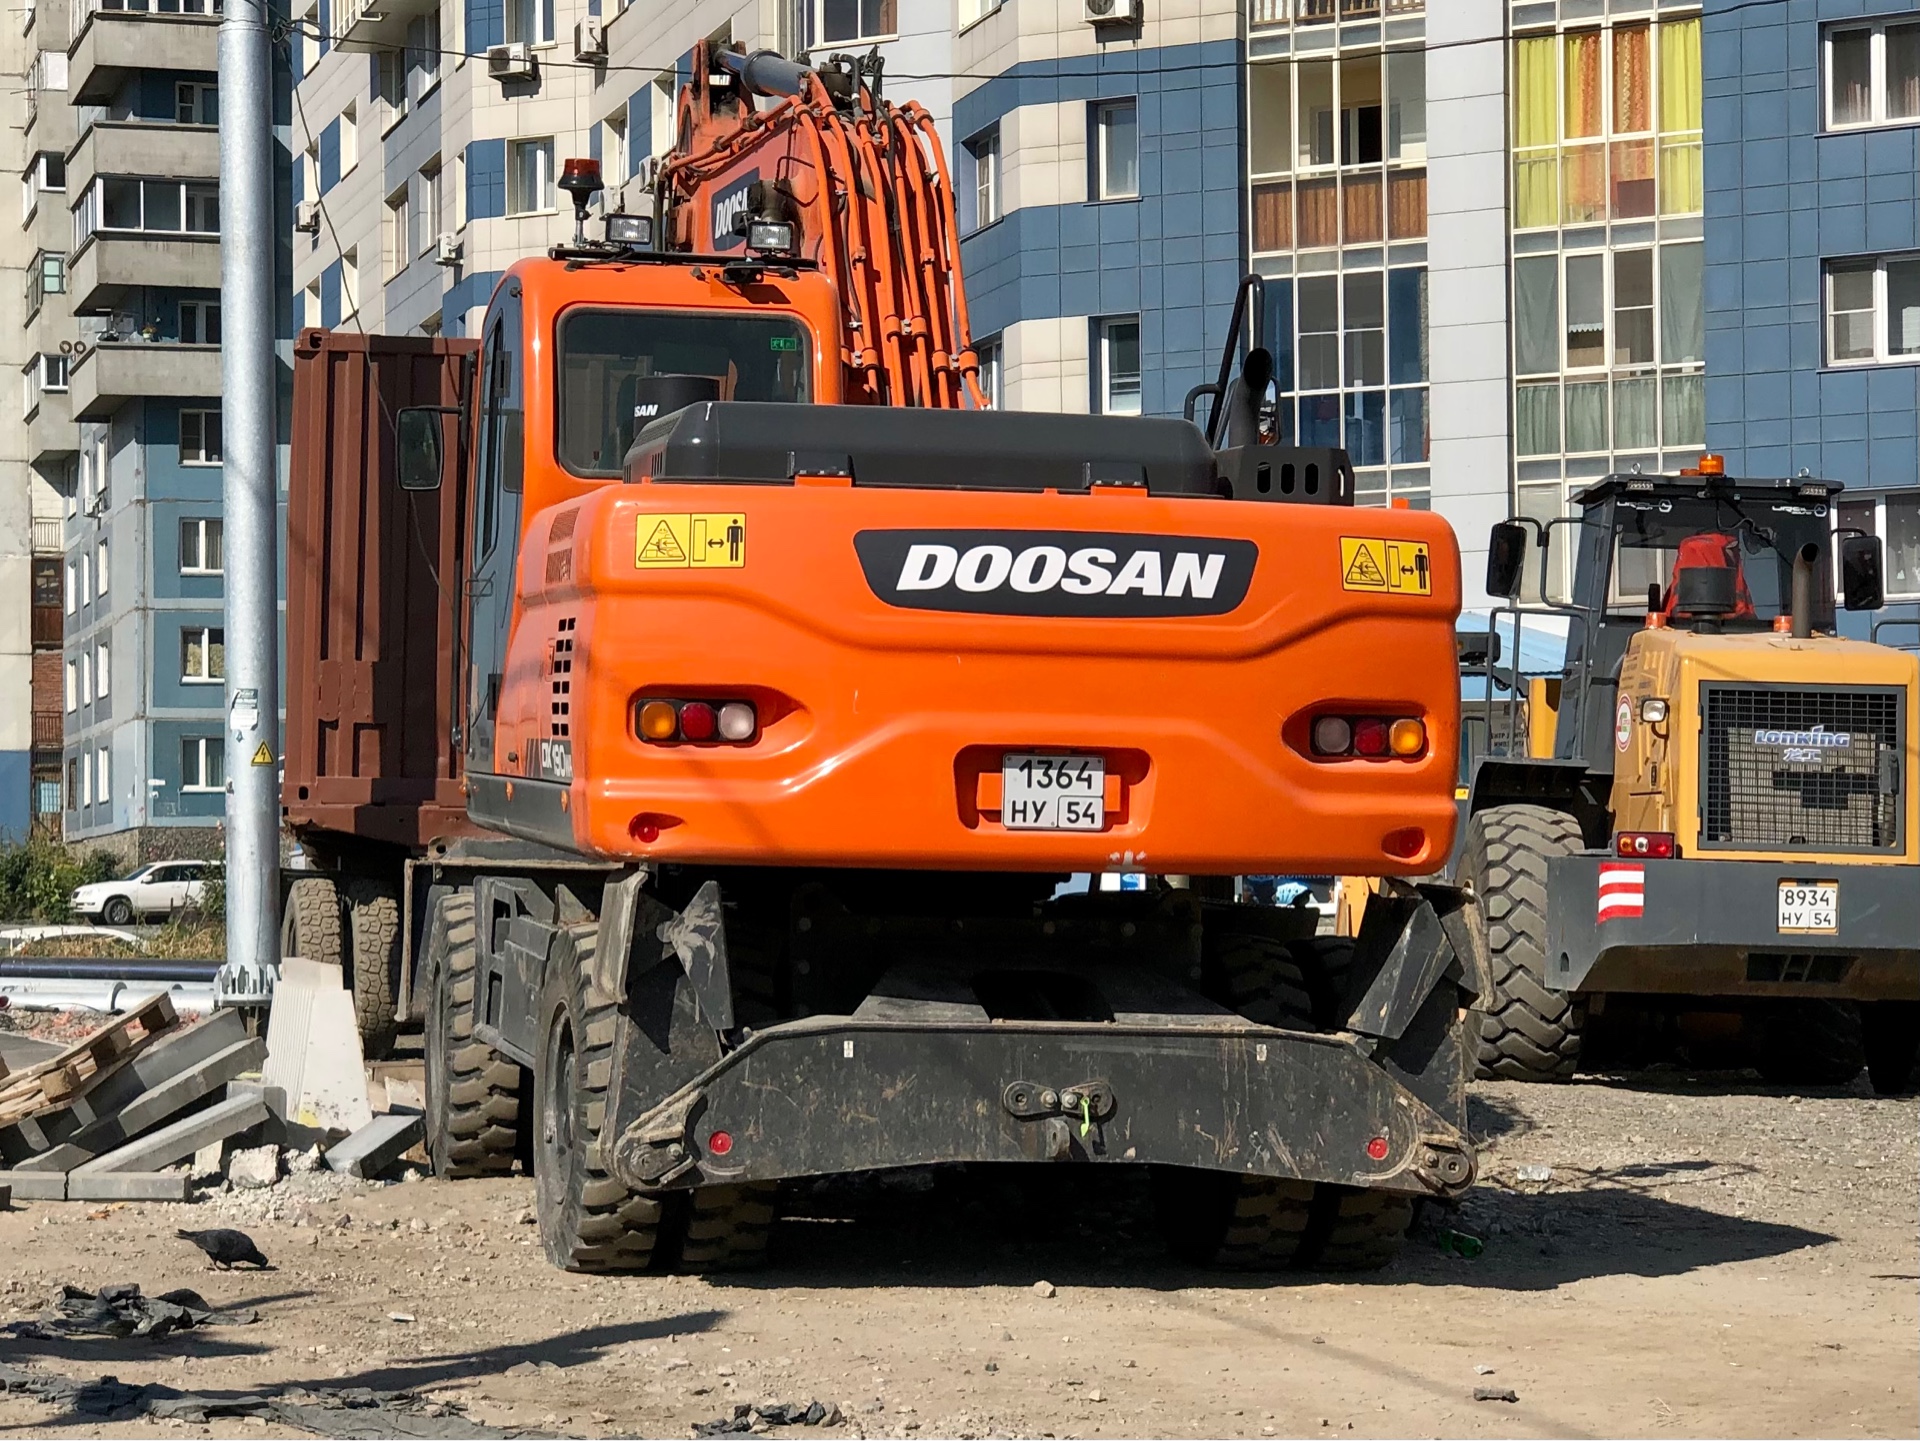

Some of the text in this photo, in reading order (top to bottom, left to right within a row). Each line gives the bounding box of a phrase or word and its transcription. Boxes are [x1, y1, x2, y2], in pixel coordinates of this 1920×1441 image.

[896, 544, 1225, 599] DOOSAN
[1018, 759, 1093, 790] 1364
[1011, 800, 1095, 825] НУ 54
[1784, 889, 1830, 907] 8934
[1782, 912, 1831, 926] НУ 54
